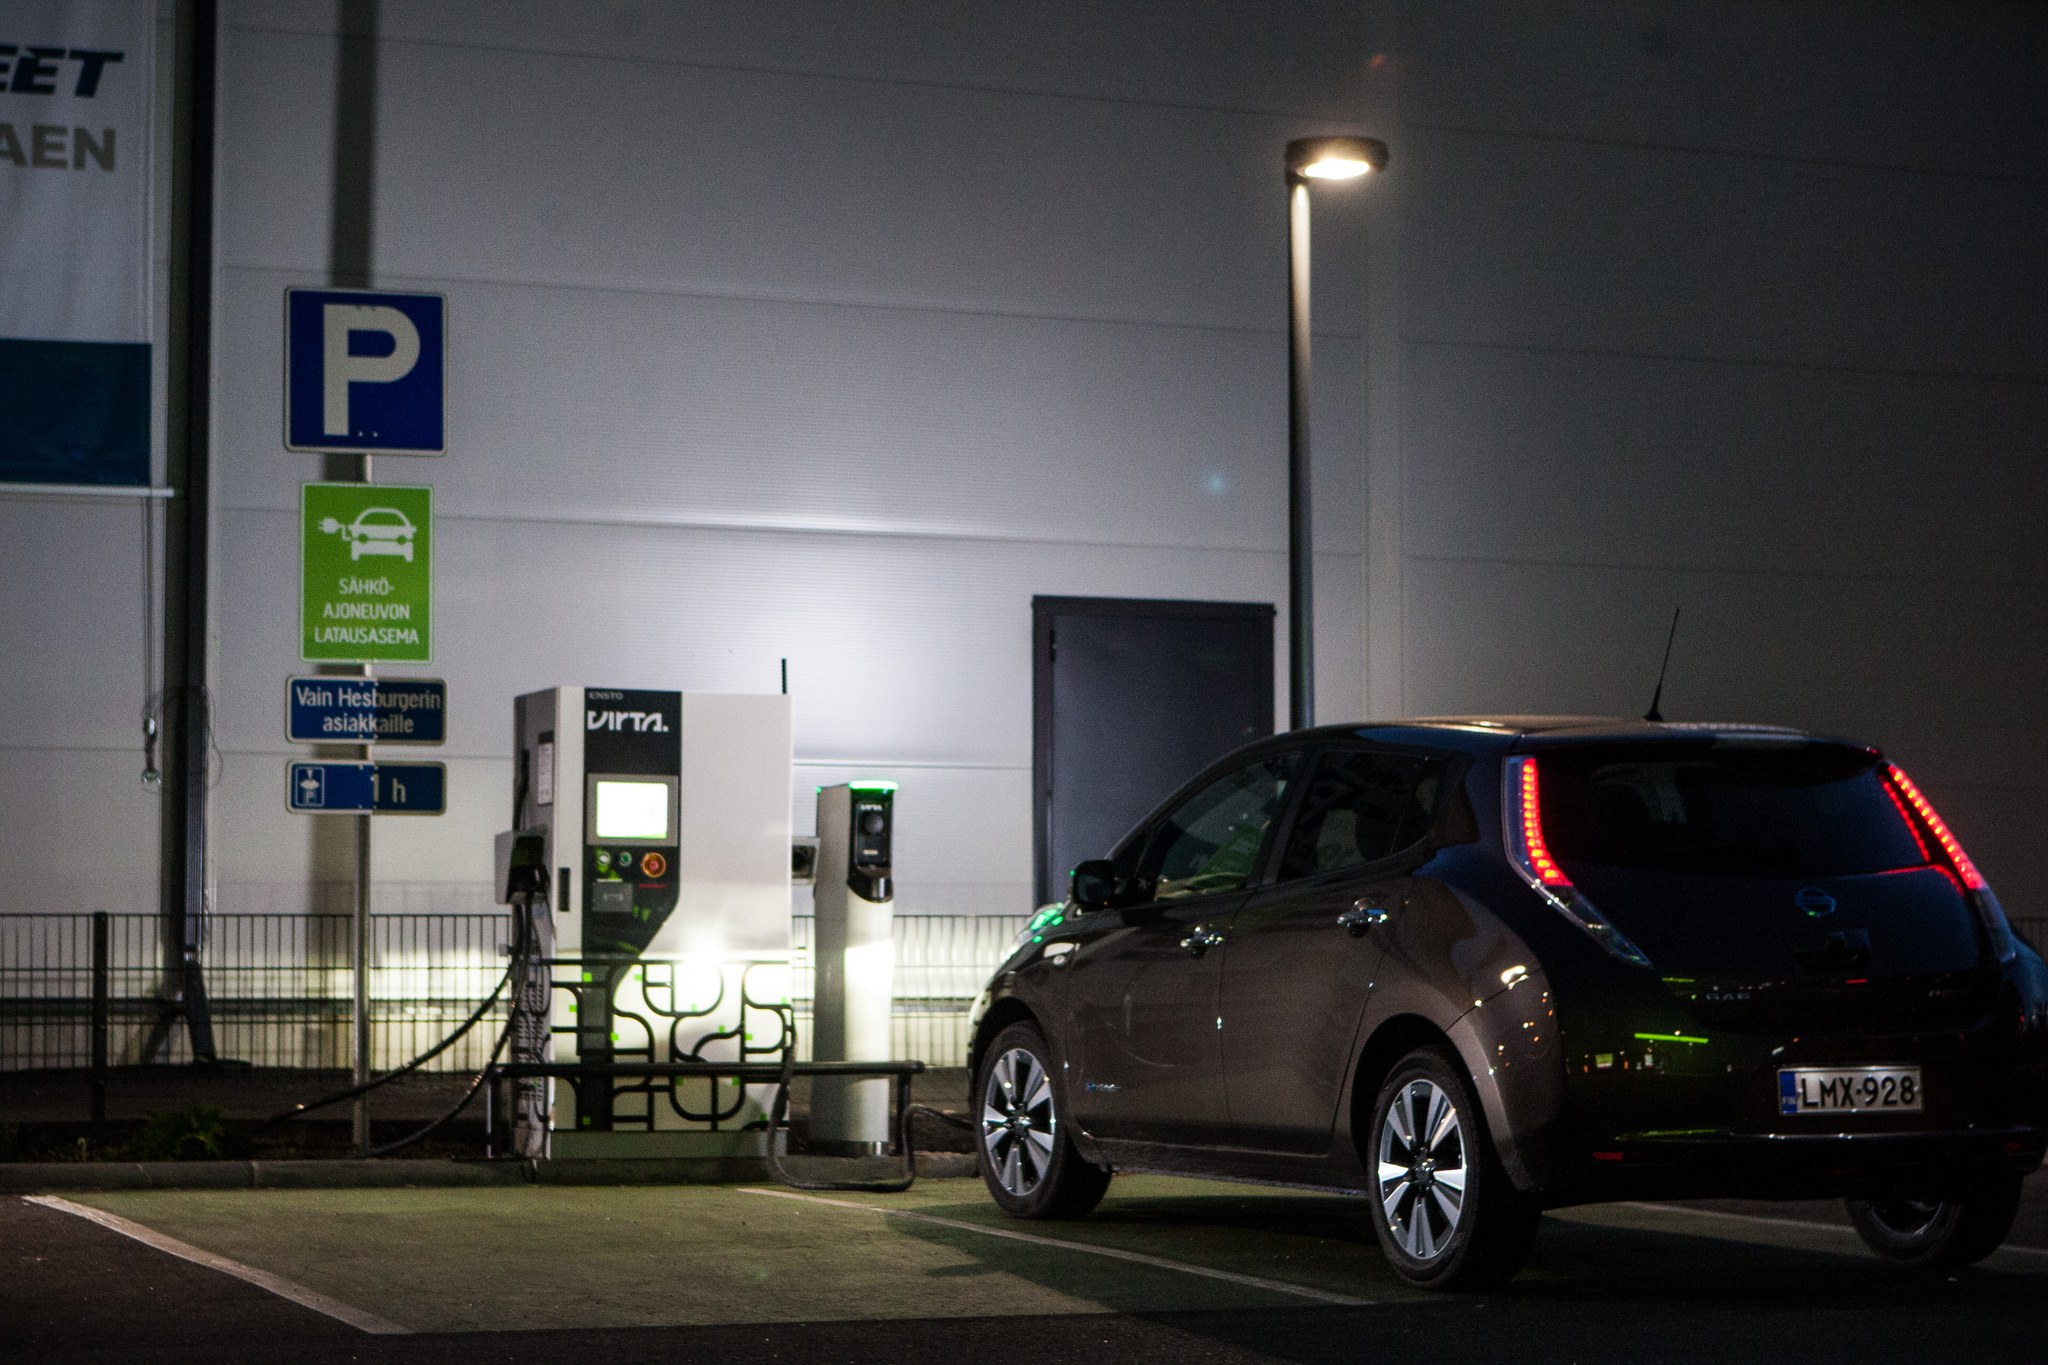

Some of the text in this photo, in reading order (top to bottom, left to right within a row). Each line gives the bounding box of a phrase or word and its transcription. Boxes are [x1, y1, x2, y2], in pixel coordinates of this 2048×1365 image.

[323, 304, 421, 436] P
[339, 576, 394, 595] SÄHKÖ-
[323, 603, 410, 620] AJONEUVON
[314, 627, 419, 645] LATAUSASEMA
[296, 686, 441, 712] Vain Hesburgerin
[588, 691, 624, 700] ENSTO
[323, 713, 414, 733] asiakkaille
[371, 773, 406, 803] 1 h
[1800, 1076, 1916, 1108] LMX-928
